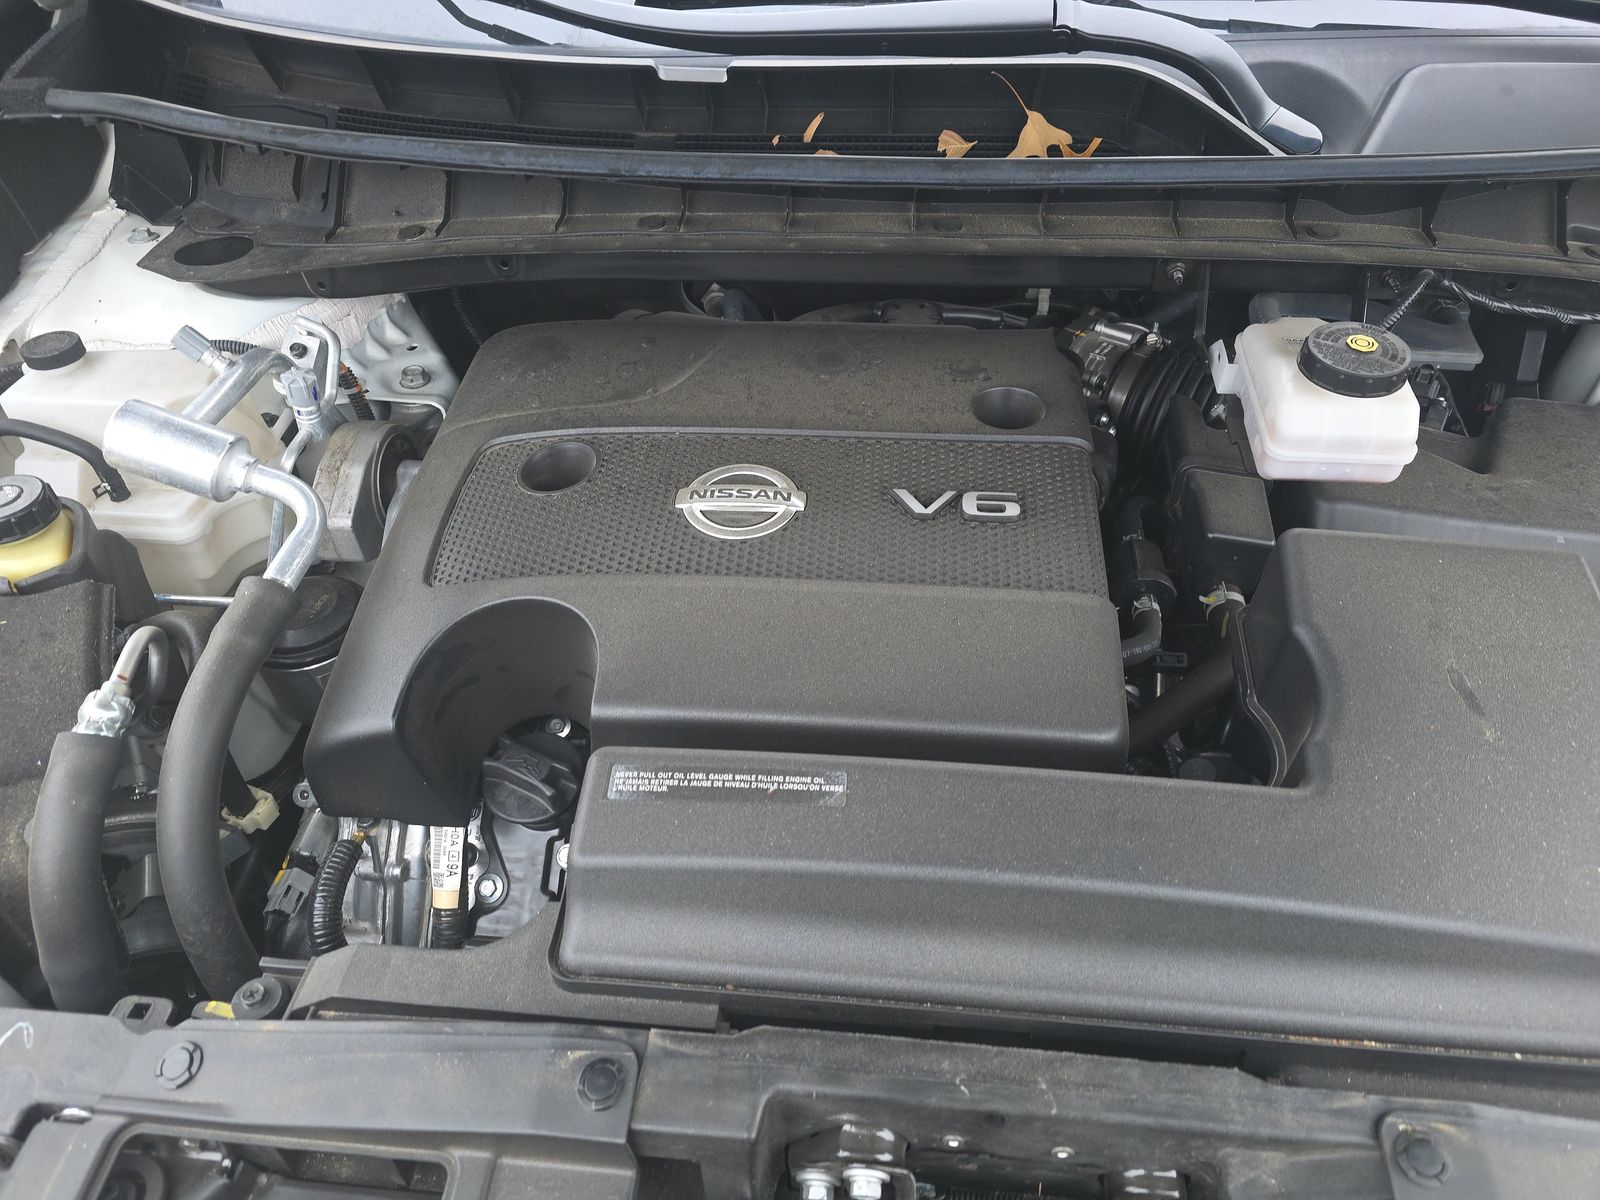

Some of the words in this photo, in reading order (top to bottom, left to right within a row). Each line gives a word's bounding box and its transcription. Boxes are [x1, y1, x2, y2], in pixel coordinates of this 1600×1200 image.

[689, 488, 792, 502] NISSAN
[892, 488, 1022, 521] V6
[615, 770, 638, 778] NEVER
[686, 772, 707, 780] LEVEL
[708, 773, 734, 781] GAUGE
[735, 773, 757, 781] WHILE
[757, 774, 784, 782] FILLING
[785, 775, 812, 783] ENGINE
[650, 778, 679, 786] RETIRER
[679, 779, 689, 787] LA
[689, 779, 712, 787] JAUGE
[713, 780, 724, 788] DE
[724, 780, 750, 788] NIVEAU
[751, 781, 778, 789] D'HUILE
[779, 783, 820, 791] LORSQU'ON
[821, 784, 844, 793] VERSE
